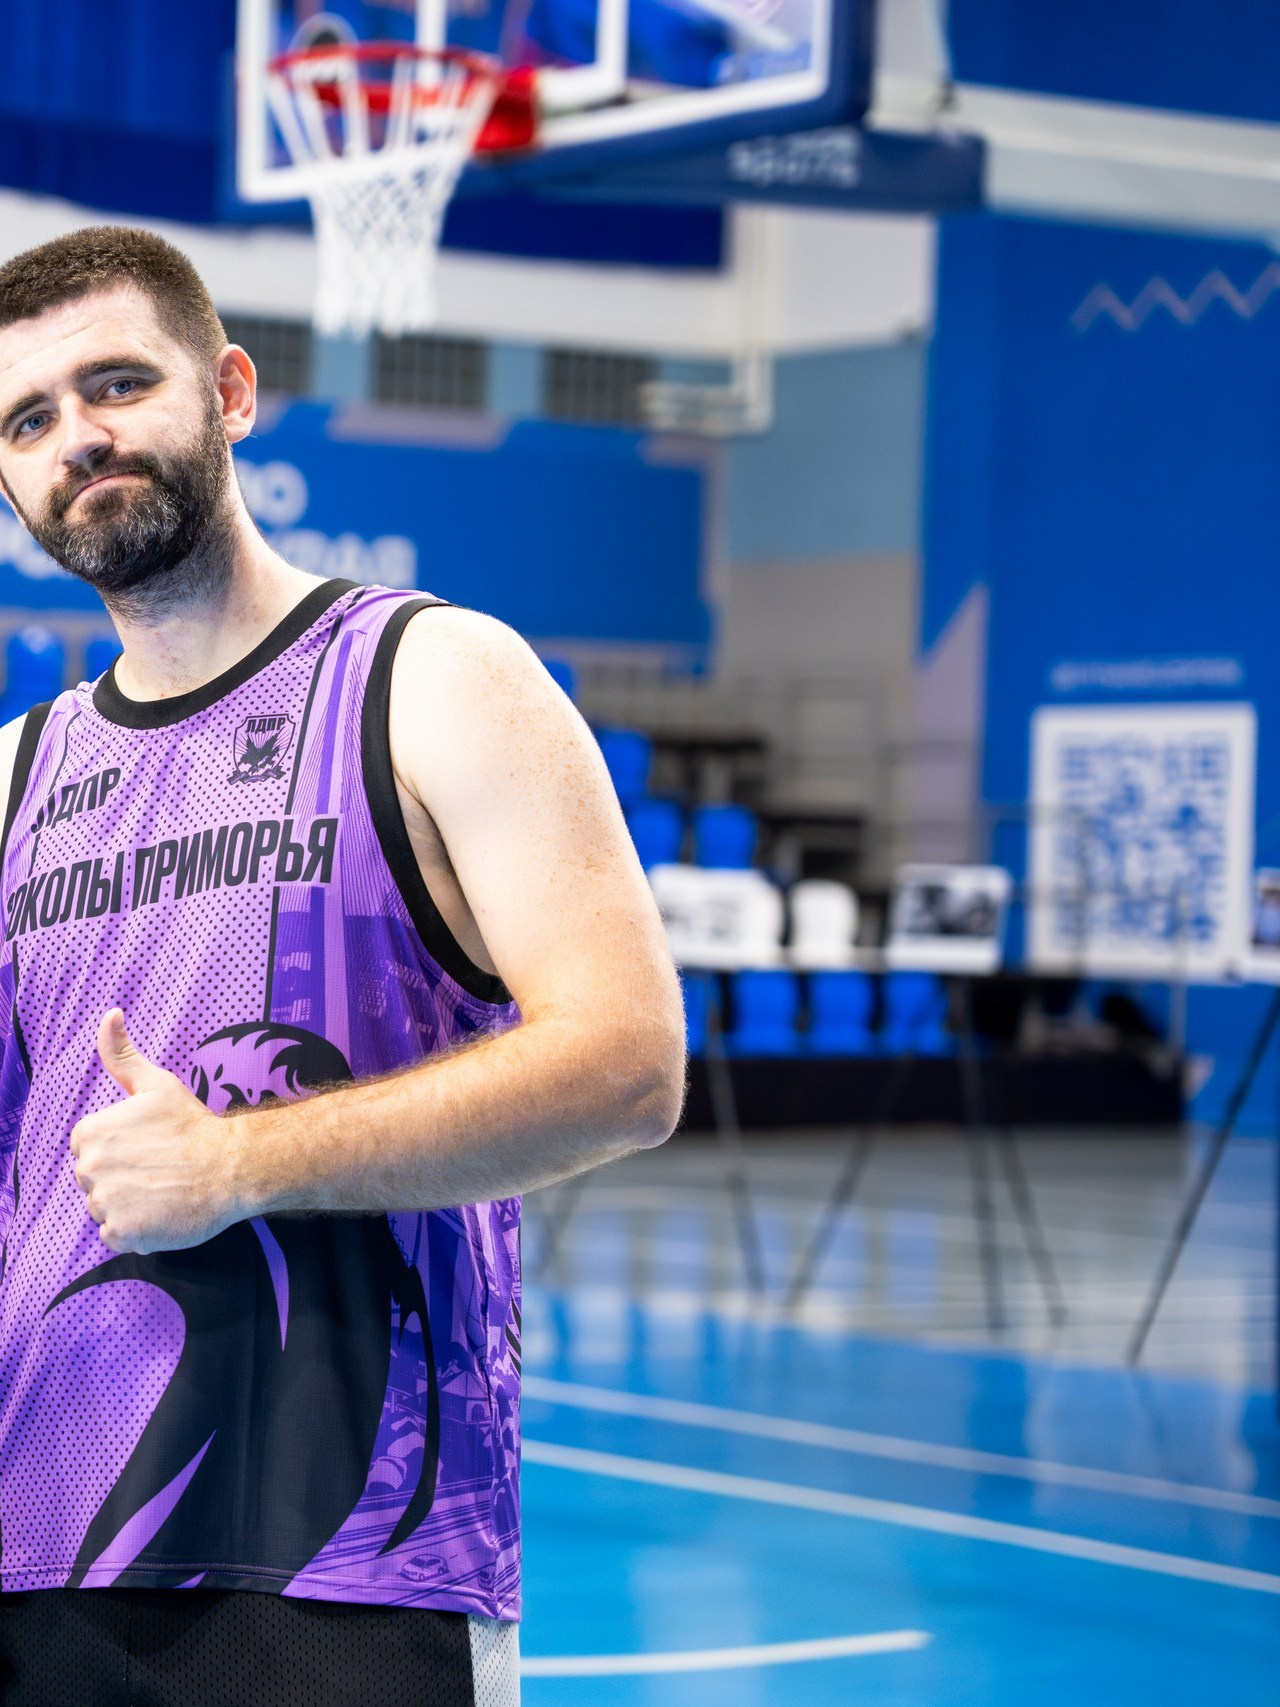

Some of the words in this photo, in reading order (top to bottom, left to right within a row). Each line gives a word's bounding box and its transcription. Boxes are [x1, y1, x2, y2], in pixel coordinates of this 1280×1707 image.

[245, 717, 286, 734] ЛДПР
[31, 767, 121, 833] ЛДПР
[131, 818, 339, 912] ПРИМОРЬЯ
